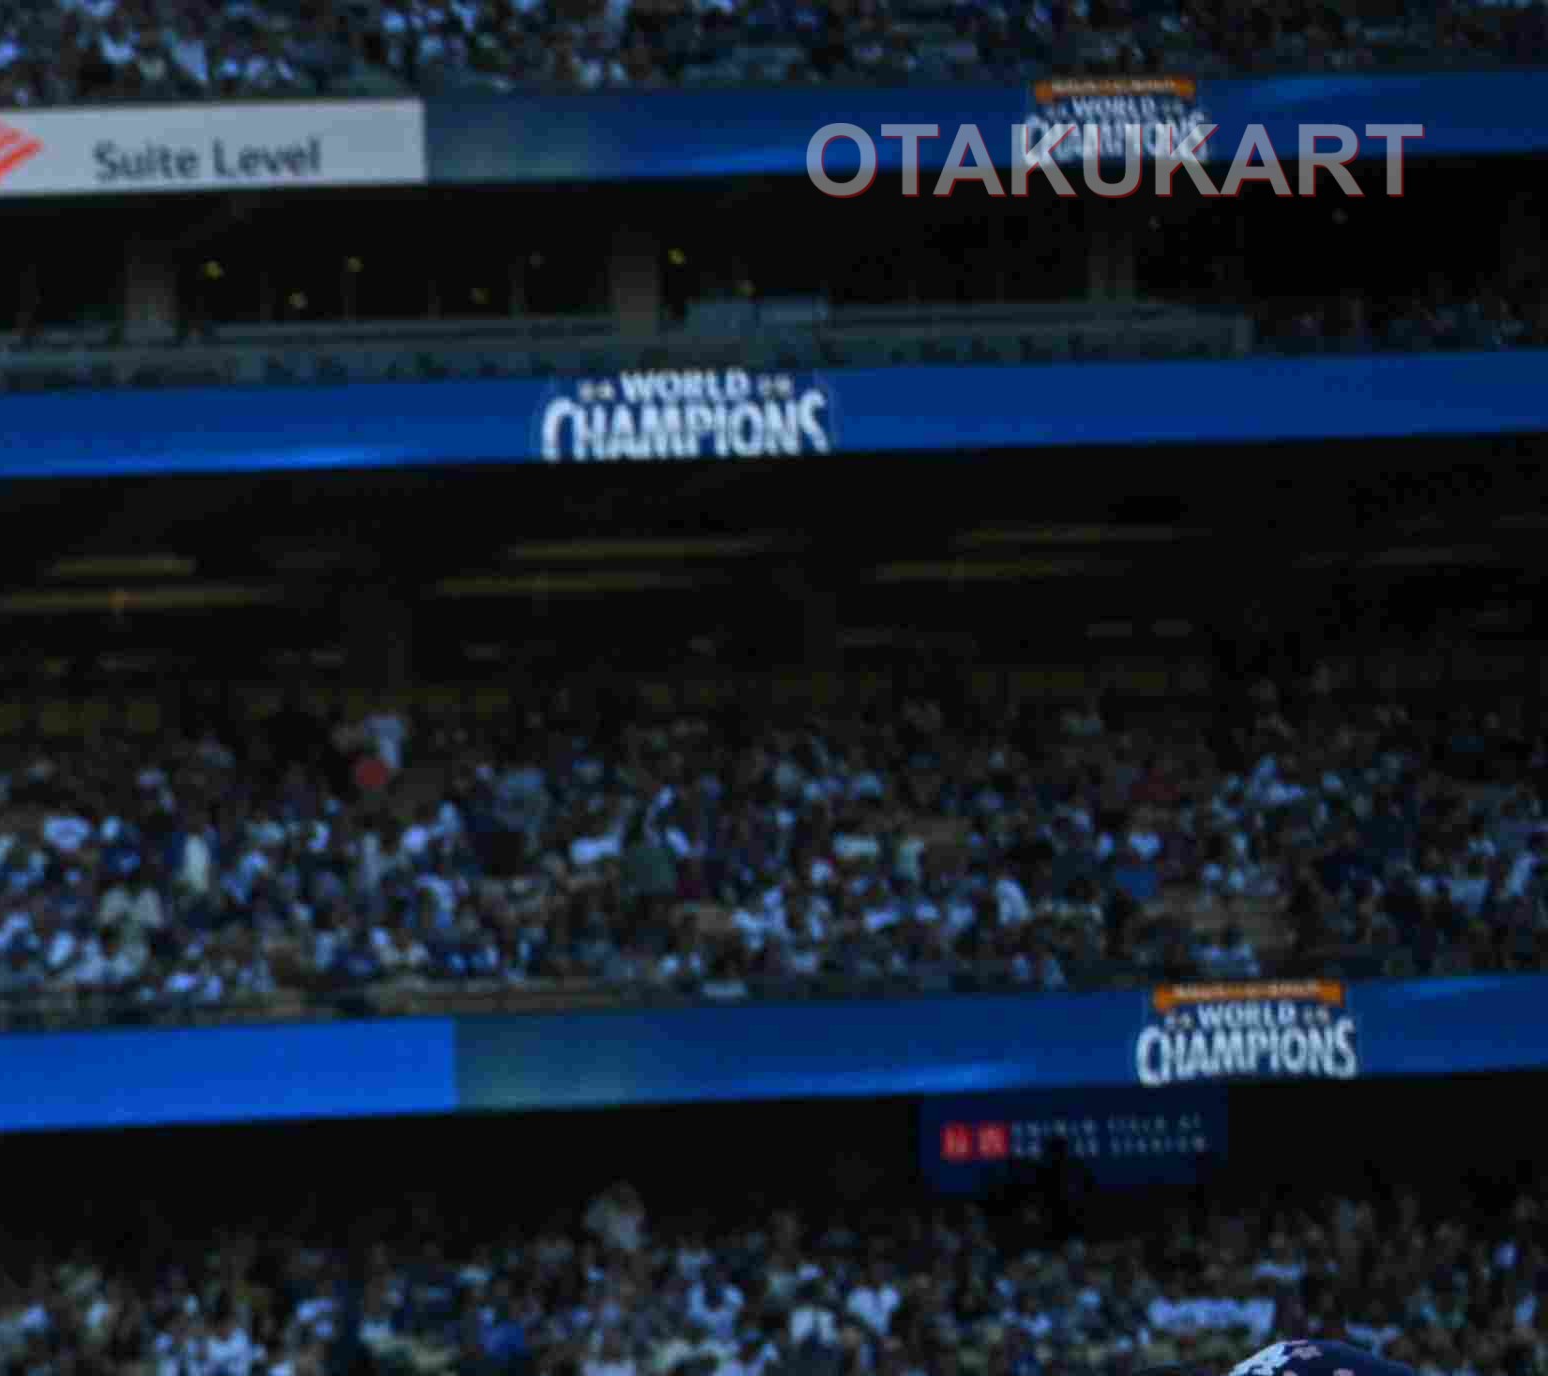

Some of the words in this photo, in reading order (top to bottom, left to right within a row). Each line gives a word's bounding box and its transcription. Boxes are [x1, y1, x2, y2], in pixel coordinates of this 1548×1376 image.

[92, 140, 202, 183] Suite
[213, 138, 322, 178] Level
[619, 367, 752, 402] WORLD
[1197, 1001, 1295, 1028] WORLD
[1135, 1017, 1357, 1086] CHAMPIONS
